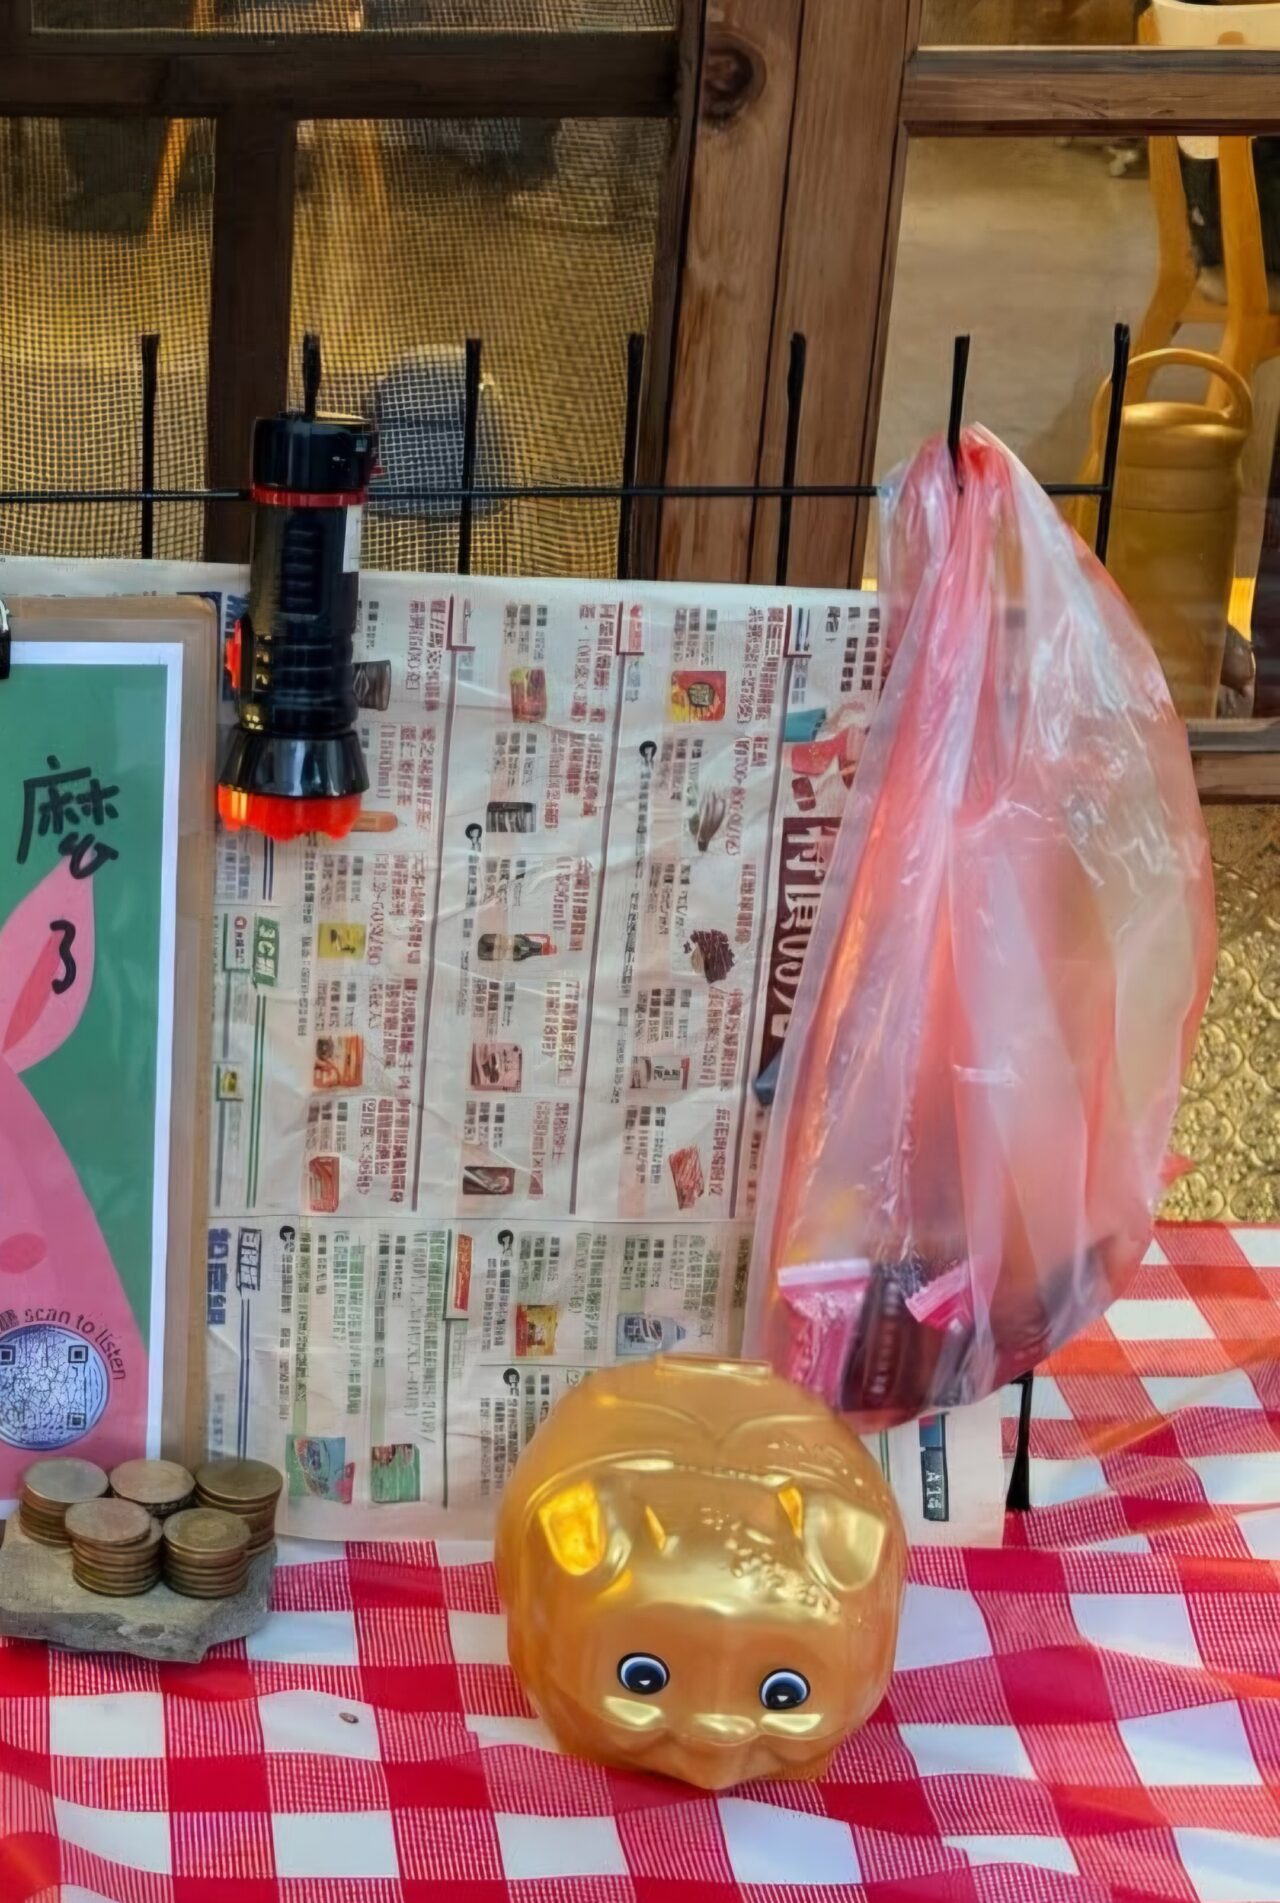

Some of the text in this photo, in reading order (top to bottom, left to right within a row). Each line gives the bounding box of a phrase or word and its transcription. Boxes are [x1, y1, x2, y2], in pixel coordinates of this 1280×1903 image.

[25, 1308, 127, 1380] scan to listen
